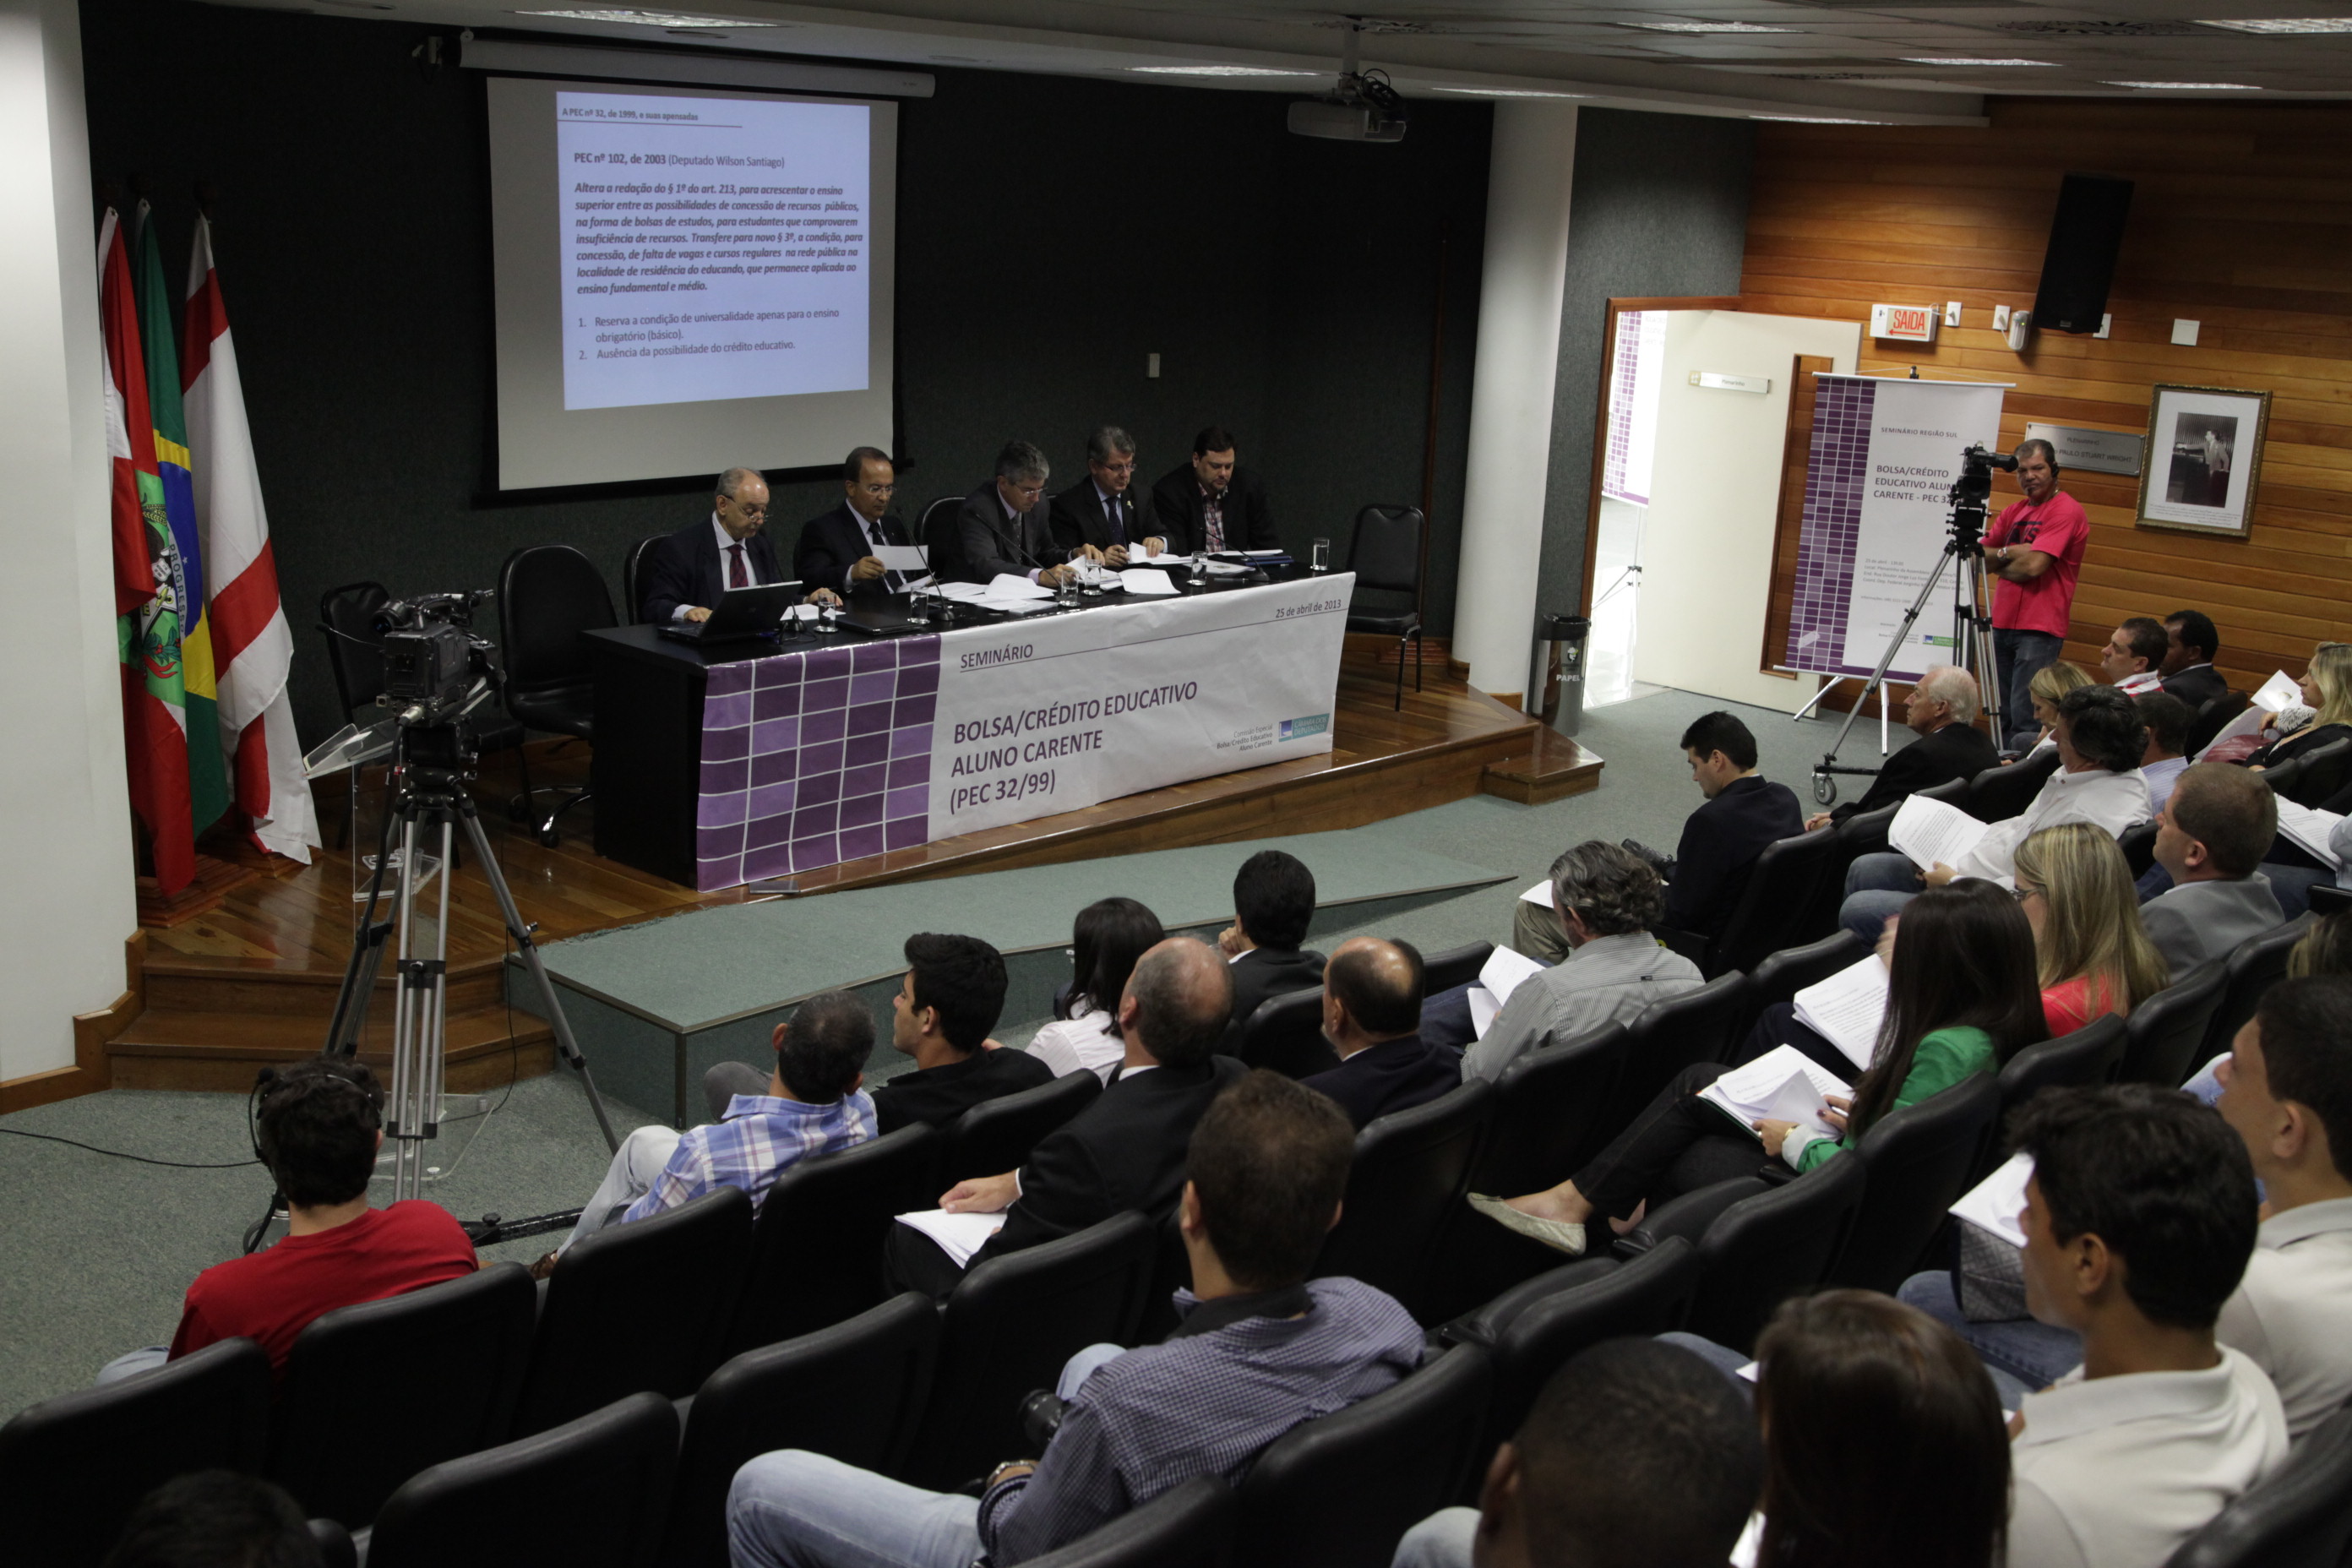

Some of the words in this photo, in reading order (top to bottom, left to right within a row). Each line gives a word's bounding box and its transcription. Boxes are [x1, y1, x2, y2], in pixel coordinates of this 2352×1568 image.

[596, 110, 606, 118] 32,
[608, 109, 617, 117] de
[619, 111, 638, 119] 1999,
[662, 112, 698, 121] apensadas
[574, 153, 592, 163] PEC
[608, 154, 628, 165] 102,
[630, 154, 641, 164] de
[645, 155, 666, 164] 2003
[668, 155, 714, 166] (Deputado
[716, 155, 744, 166] Wilson
[747, 157, 784, 169] Santiago)
[574, 182, 605, 193] Altera
[615, 182, 652, 195] redação
[654, 183, 666, 193] do
[688, 183, 699, 193] do
[701, 185, 716, 193] art.
[719, 184, 737, 195] 213,
[739, 187, 760, 196] para
[817, 186, 843, 195] ensino
[575, 200, 615, 212] superior
[617, 201, 641, 210] entre
[656, 200, 716, 212] possibilidades
[719, 200, 729, 210] de
[732, 200, 774, 210] concessão
[776, 201, 786, 210] de
[825, 201, 858, 212] públicos,
[589, 216, 618, 229] forma
[621, 216, 633, 226] de
[634, 216, 662, 226] bolsas
[665, 216, 677, 226] de
[678, 216, 714, 227] estudos,
[716, 219, 737, 228] para
[738, 216, 784, 226] estudantes
[786, 219, 801, 228] que
[803, 219, 858, 228] comprovarem
[576, 233, 634, 246] insuficiência
[635, 233, 647, 243] de
[692, 232, 732, 244] Transfere
[733, 235, 753, 244] para
[805, 232, 842, 243] condição,
[844, 235, 863, 243] para
[576, 250, 626, 261] concessão,
[629, 249, 640, 259] de
[641, 249, 664, 261] falta
[665, 248, 677, 259] de
[678, 251, 704, 260] vagas
[743, 248, 781, 259] regulares
[798, 248, 816, 257] rede
[817, 248, 846, 259] pública
[577, 266, 625, 277] localidade
[627, 266, 638, 275] de
[640, 265, 686, 275] residência
[688, 264, 699, 275] do
[701, 264, 744, 275] educando,
[747, 266, 763, 275] que
[764, 265, 809, 275] permanece
[577, 284, 608, 294] ensino
[609, 281, 669, 295] fundamental
[678, 280, 707, 291] médio.
[579, 318, 586, 327] 1.
[596, 317, 629, 326] Reserva
[640, 314, 679, 325] condição
[681, 313, 692, 323] de
[694, 311, 754, 322] universalidade
[757, 313, 785, 322] apenas
[787, 312, 804, 321] para
[814, 309, 839, 318] ensino
[596, 331, 645, 344] obrigatório
[648, 329, 683, 341] (básico).
[580, 351, 587, 360] 2.
[597, 348, 637, 358] Ausência
[640, 347, 651, 357] da
[653, 344, 709, 358] possibilidade
[710, 343, 721, 352] do
[724, 342, 752, 351] crédito
[754, 340, 795, 351] educativo.
[1881, 427, 1918, 435] SEMINÁRIO
[1919, 428, 1944, 437] REGIÃO
[2081, 451, 2105, 460] STUART
[2106, 455, 2132, 463] WRIGHT
[1876, 465, 1949, 478] BOLSA/CRÉDITO
[1875, 477, 1926, 489] EDUCATIVO
[1929, 482, 1954, 491] ALUN
[1874, 490, 1914, 500] CARENTE
[1922, 494, 1939, 503] PEC
[169, 543, 186, 633] PROGRESSO
[1276, 608, 1285, 618] 25
[1286, 607, 1294, 617] de
[1296, 603, 1313, 615] abril
[1313, 602, 1322, 612] de
[1324, 599, 1342, 610] 2013
[960, 644, 1033, 668] SEMINÁRIO
[954, 701, 1100, 744] BOLSA/CRÉDITO
[1104, 681, 1198, 716] EDUCATIVO
[1233, 727, 1255, 738] Comissão
[1255, 723, 1272, 734] Especial
[1294, 719, 1315, 728] CÂMARA
[1294, 724, 1325, 736] DEPUTADOS
[1217, 737, 1250, 749] Bolsa/Crédito
[1250, 732, 1272, 742] Educativo
[1239, 743, 1254, 752] Aluno
[1255, 740, 1272, 749] Carente
[950, 746, 1018, 777] ALUNO
[1023, 730, 1103, 763] CARENTE
[950, 782, 991, 814] (PEC
[995, 769, 1056, 801] 32/99)
